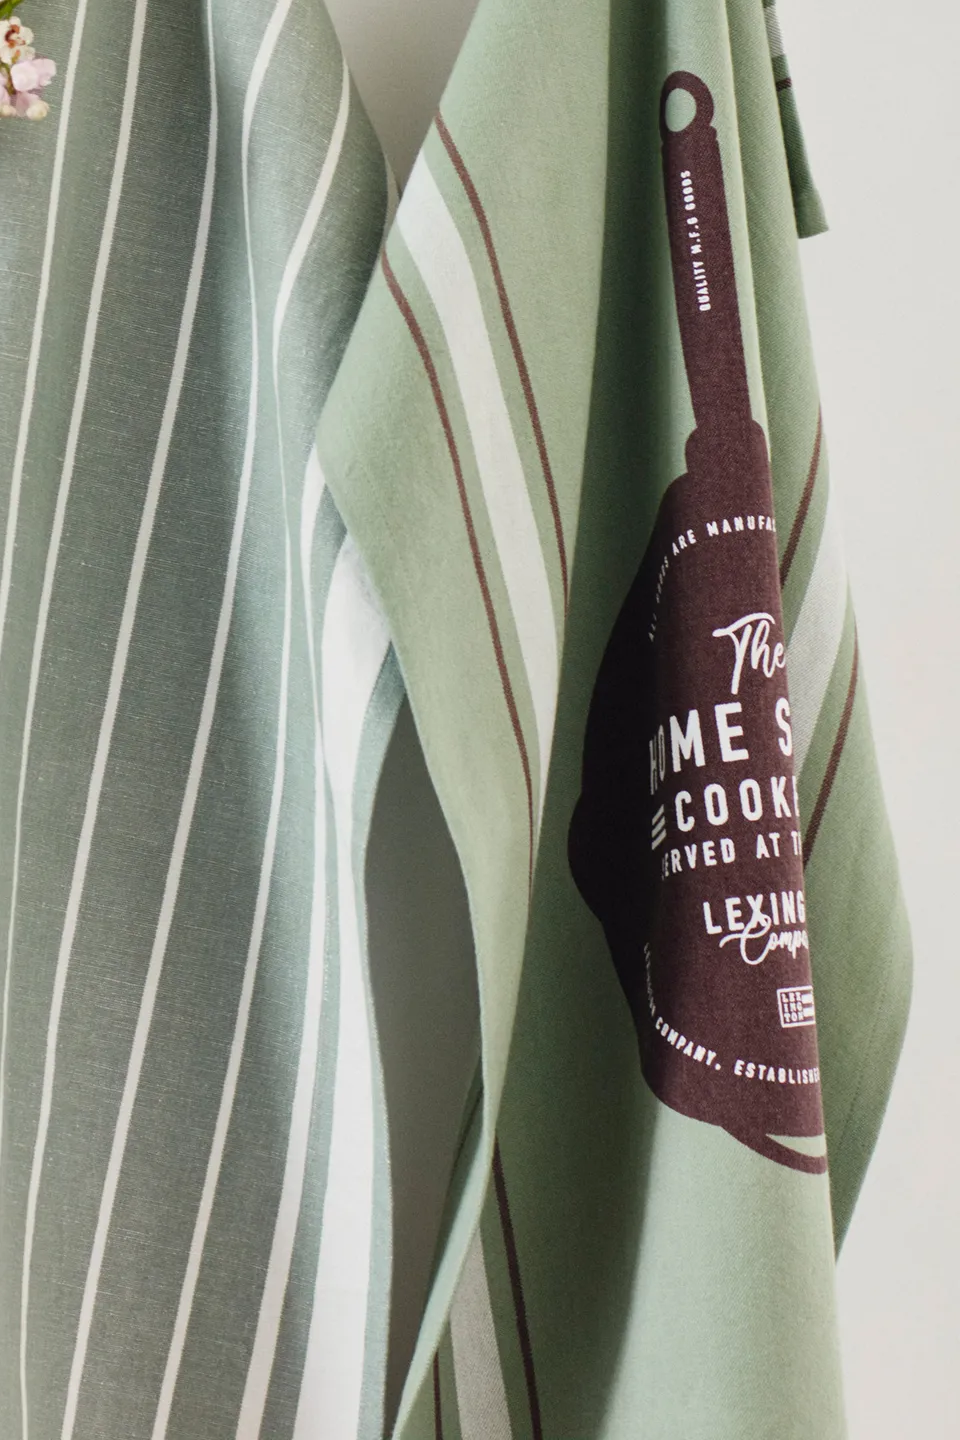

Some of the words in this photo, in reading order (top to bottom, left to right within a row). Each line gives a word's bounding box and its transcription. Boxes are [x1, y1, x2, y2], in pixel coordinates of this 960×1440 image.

[679, 169, 696, 211] GOODS
[691, 260, 712, 312] QUALITY
[671, 528, 697, 556] ARE
[711, 612, 787, 696] The
[755, 831, 781, 860] AT
[655, 1016, 722, 1072] COMPANY.
